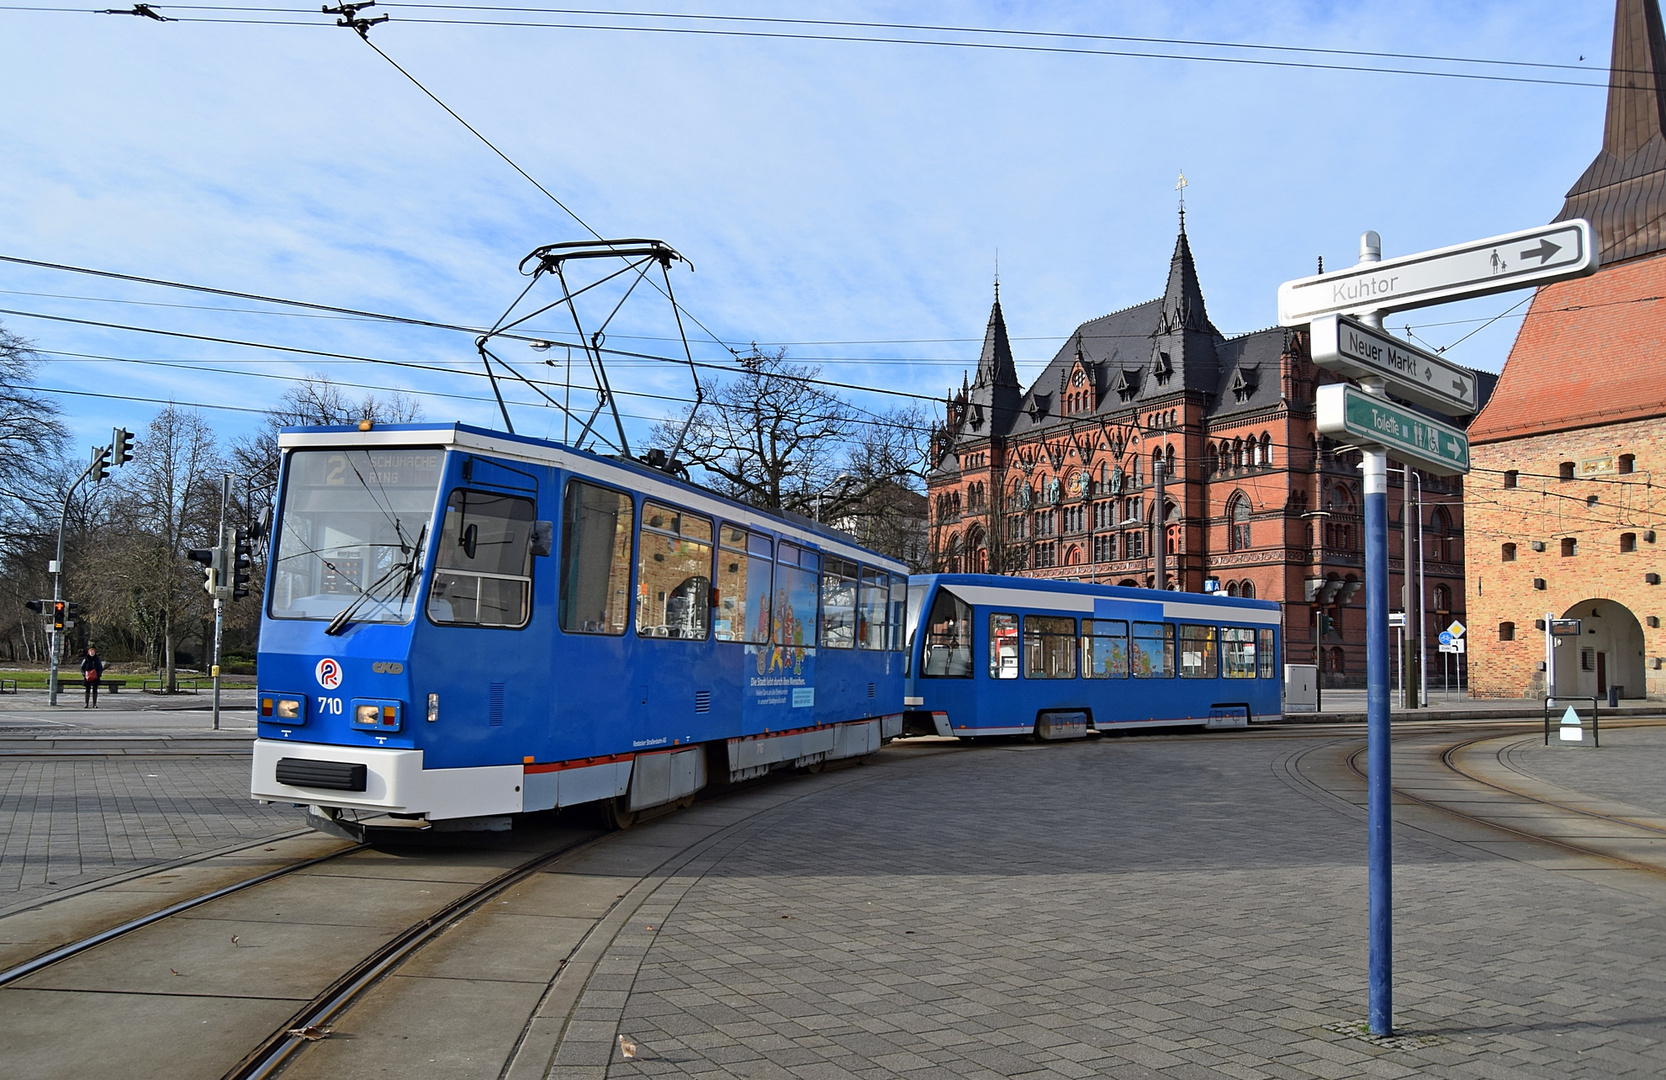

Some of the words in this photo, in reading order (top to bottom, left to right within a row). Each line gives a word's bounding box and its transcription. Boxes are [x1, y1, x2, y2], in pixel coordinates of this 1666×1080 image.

[1333, 276, 1398, 302] Kuhtor
[1350, 332, 1382, 361] Neuer
[1388, 347, 1417, 376] Markt
[1372, 409, 1400, 436] Toilette
[326, 455, 346, 485] 2
[368, 472, 399, 484] RING
[318, 696, 343, 715] 710
